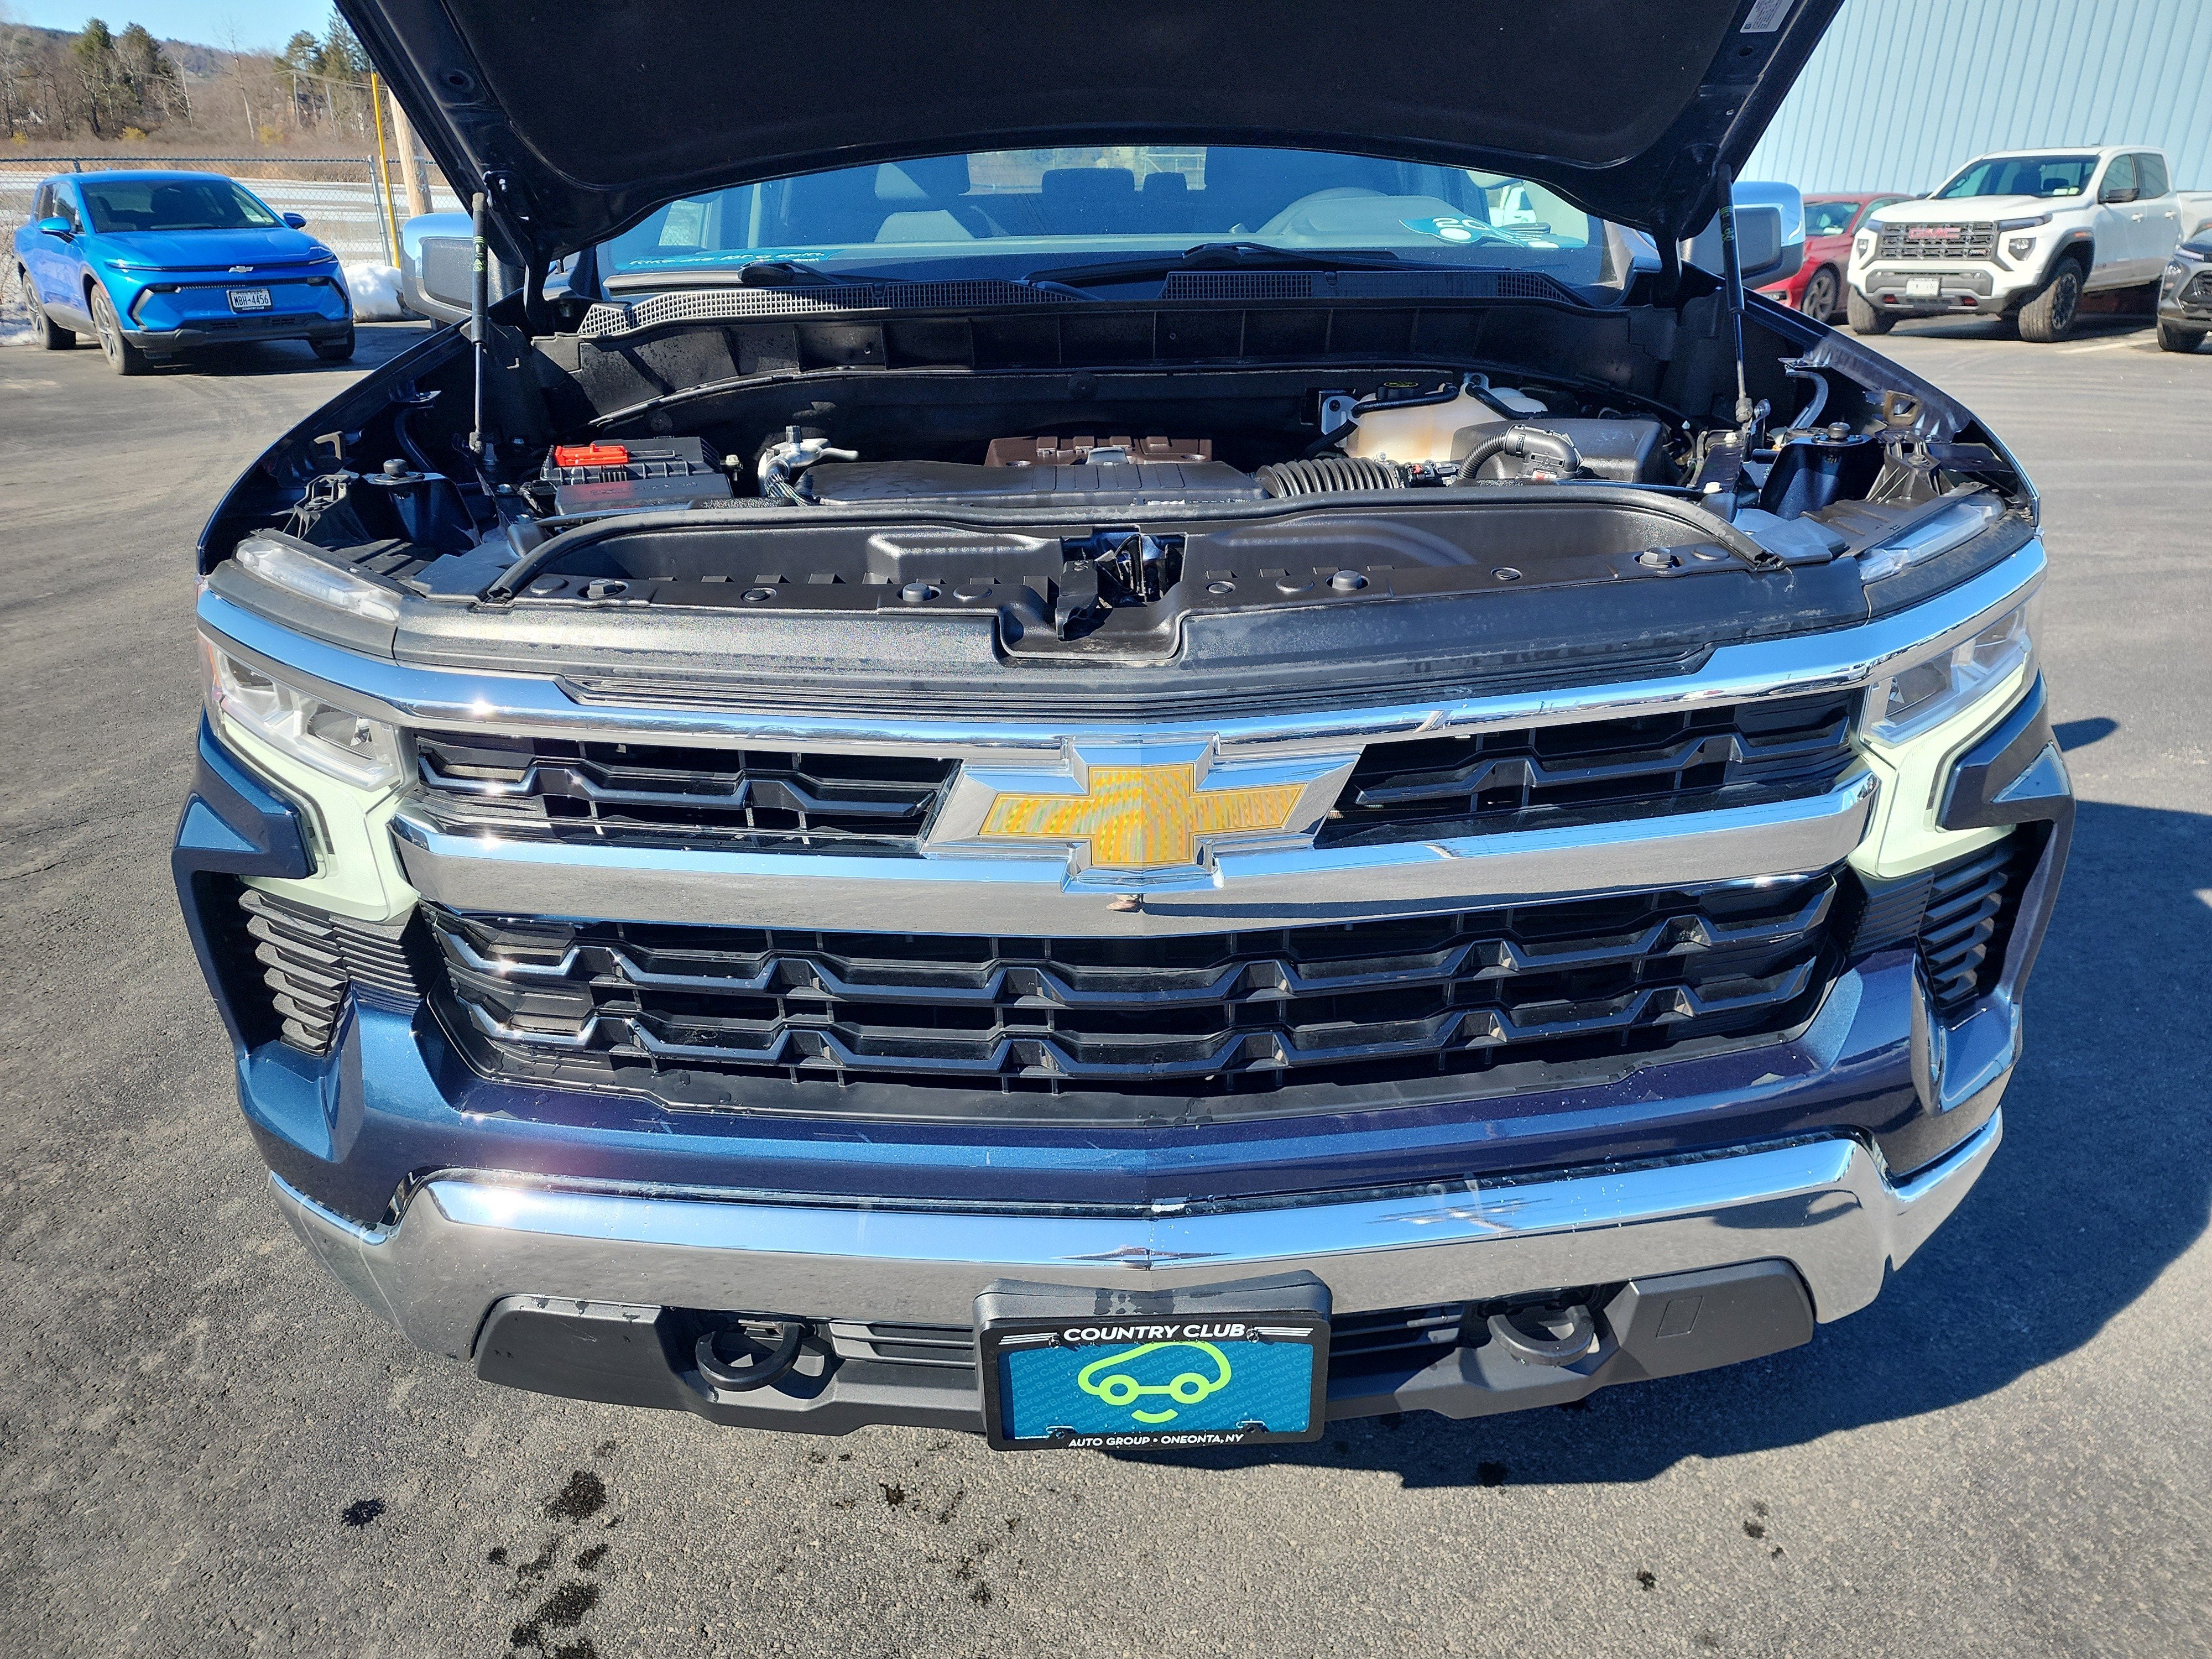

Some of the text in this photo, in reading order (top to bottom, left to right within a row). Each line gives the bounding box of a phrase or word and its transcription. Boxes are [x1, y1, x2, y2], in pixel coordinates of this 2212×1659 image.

[1908, 227, 1961, 239] GMC
[1063, 1324, 1245, 1342] COUNTRY CLUB
[1018, 1374, 1067, 1396] CarBravo
[1068, 1437, 1103, 1448] AUTO
[1106, 1436, 1150, 1446] GROUP
